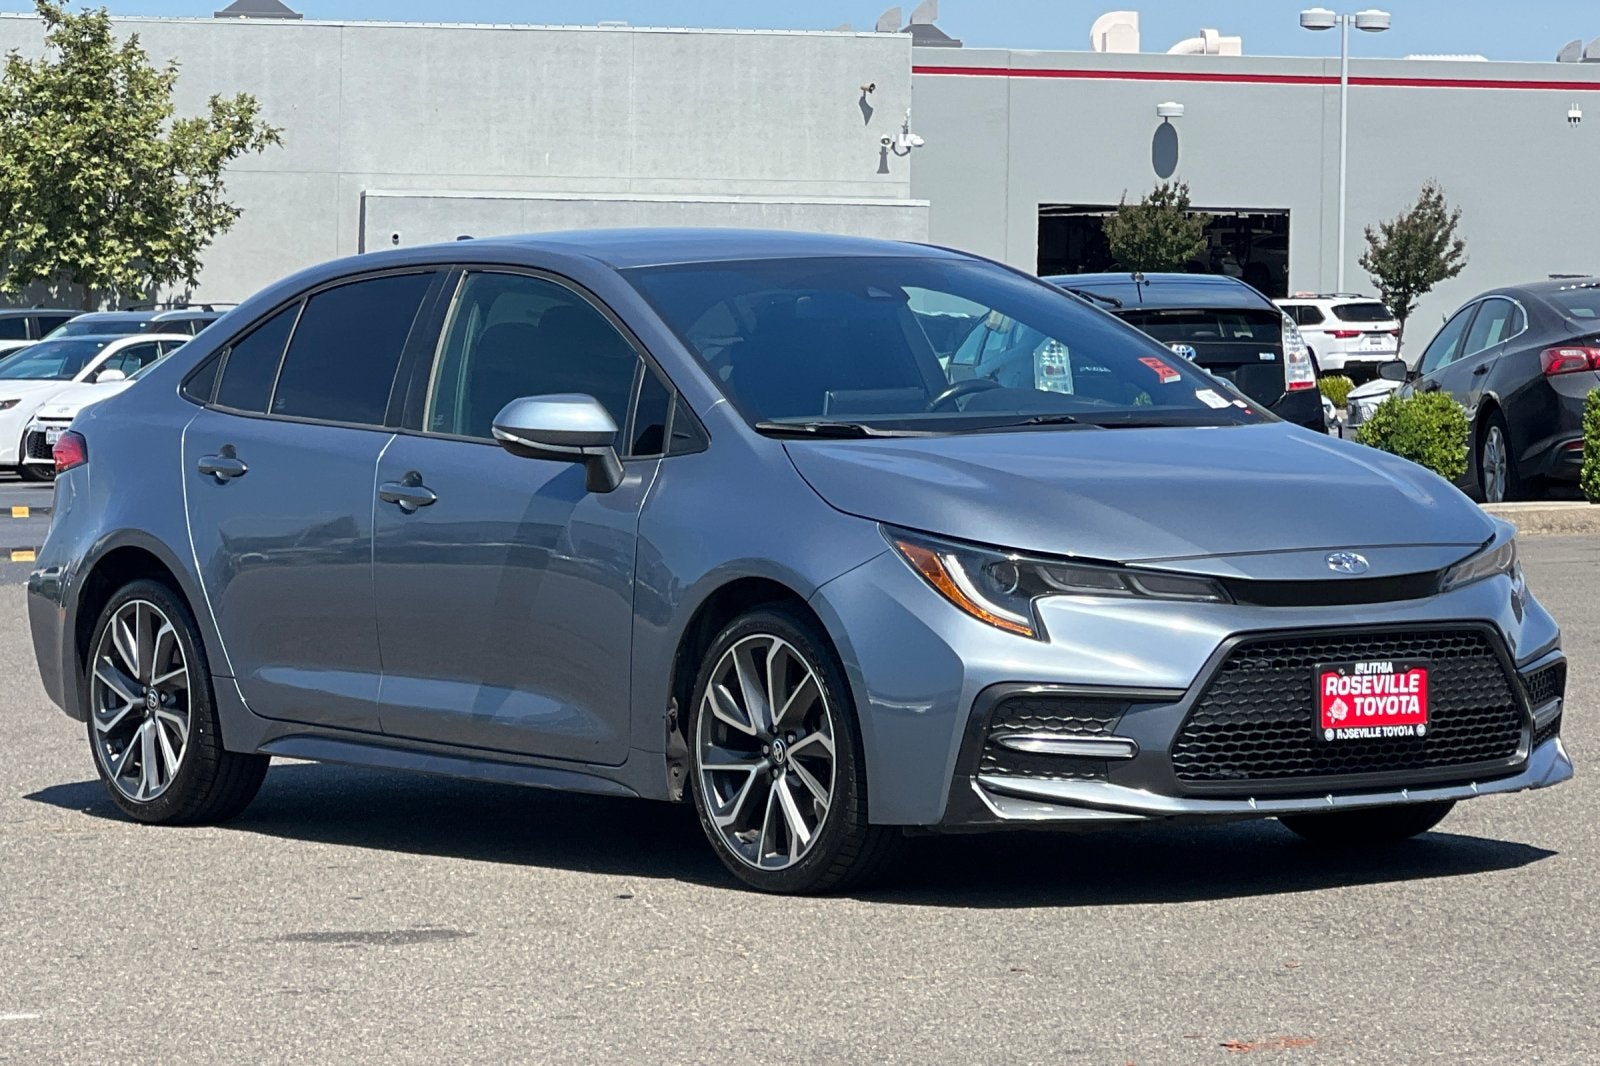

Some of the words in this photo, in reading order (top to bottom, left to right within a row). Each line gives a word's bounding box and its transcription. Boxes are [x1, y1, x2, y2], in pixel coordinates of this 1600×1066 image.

[1364, 662, 1393, 674] LITHIA
[1326, 674, 1420, 696] ROSEVILLE
[1354, 696, 1420, 717] TOYOTA
[1337, 728, 1381, 739] ROSEVILLE
[1382, 725, 1414, 736] TOYOTA
